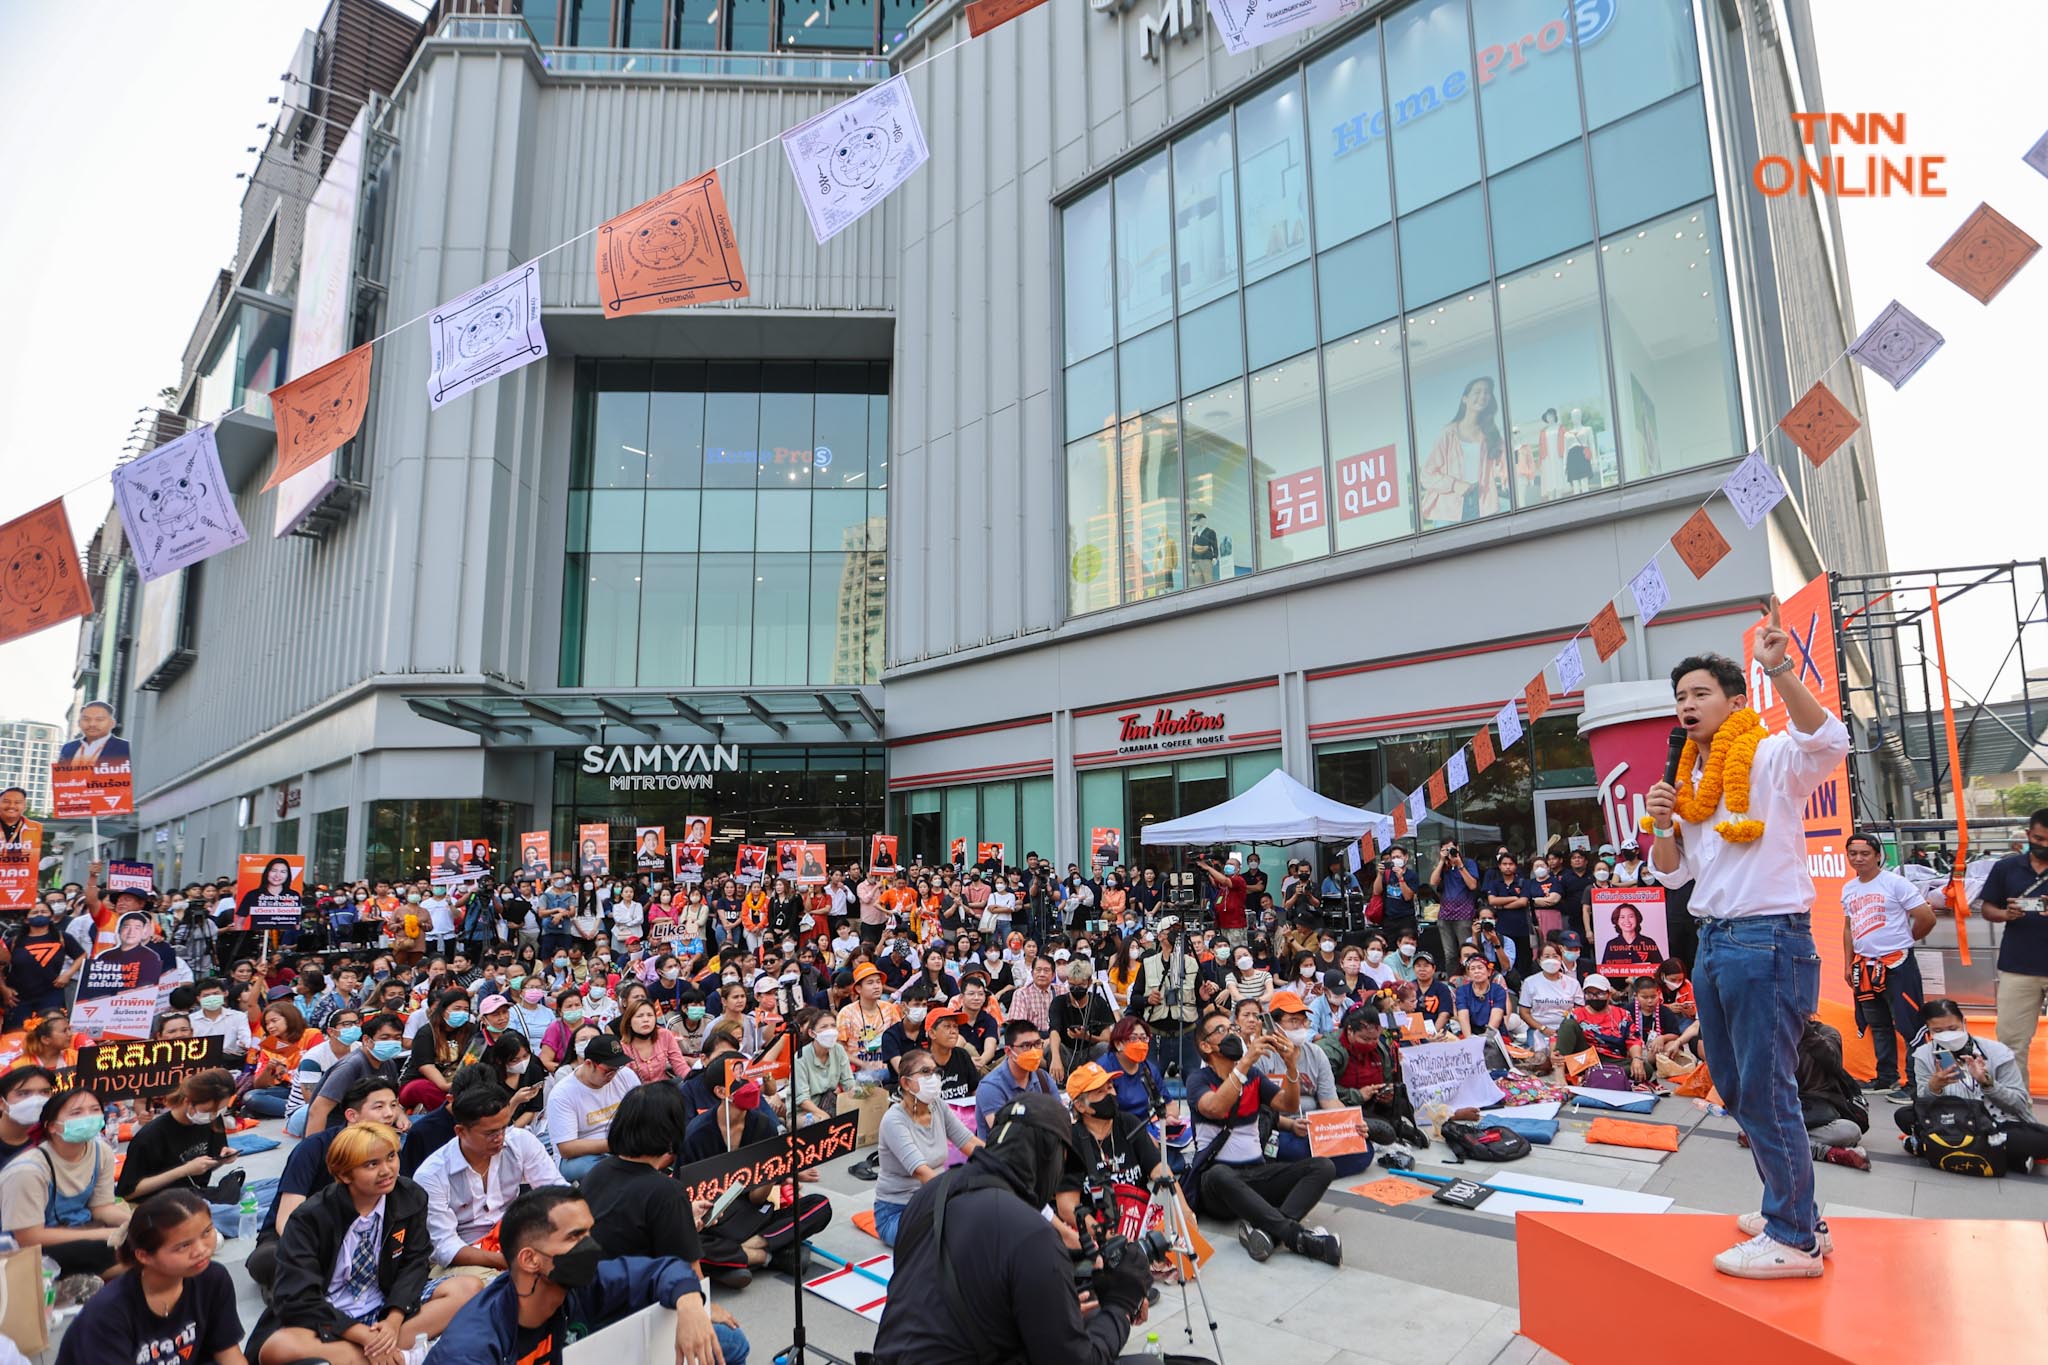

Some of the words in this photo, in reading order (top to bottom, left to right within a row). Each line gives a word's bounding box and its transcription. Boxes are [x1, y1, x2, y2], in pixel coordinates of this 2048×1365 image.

[1342, 455, 1386, 486] UNI
[1276, 475, 1316, 506] ユニ
[1344, 480, 1392, 514] QLO
[1276, 501, 1318, 531] クロ
[1118, 713, 1151, 742] Tim
[1151, 708, 1225, 737] Hortons
[582, 744, 740, 774] SAMYAN
[1119, 743, 1159, 754] CANADIAN
[1161, 738, 1192, 749] COFFEE
[1196, 734, 1225, 745] HOUSE
[609, 774, 713, 791] MITRTOWN
[654, 924, 686, 938] Like
[89, 971, 140, 981] อาหารฟรี
[90, 961, 141, 972] เรียนฟรี
[87, 979, 137, 988] รถรับส่งฟรี
[95, 1038, 208, 1071] ส.ส.กาย
[80, 1063, 217, 1094] บางขุนเทีย
